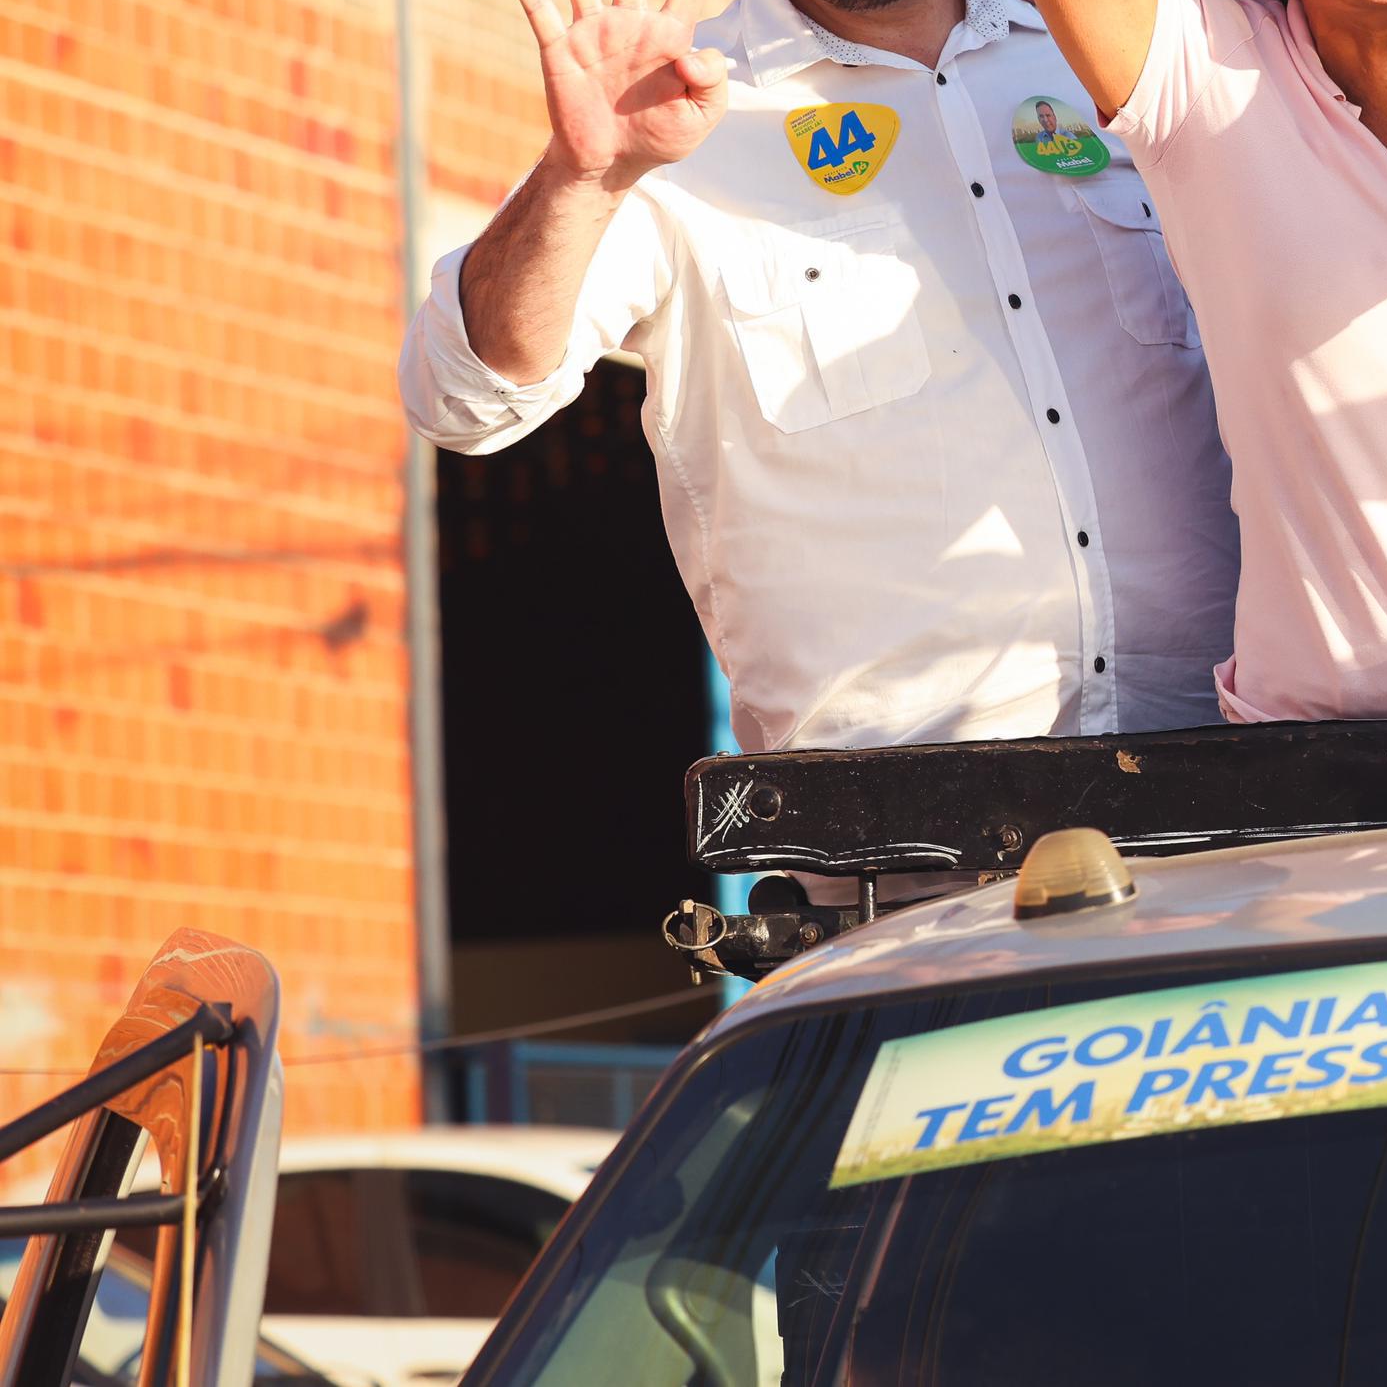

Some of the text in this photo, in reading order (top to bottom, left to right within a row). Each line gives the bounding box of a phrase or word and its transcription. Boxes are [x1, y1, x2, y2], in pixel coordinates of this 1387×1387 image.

[807, 110, 876, 170] 44
[823, 168, 856, 183] Mabel
[1056, 156, 1093, 168] Mabel
[912, 1080, 1095, 1152] TEM
